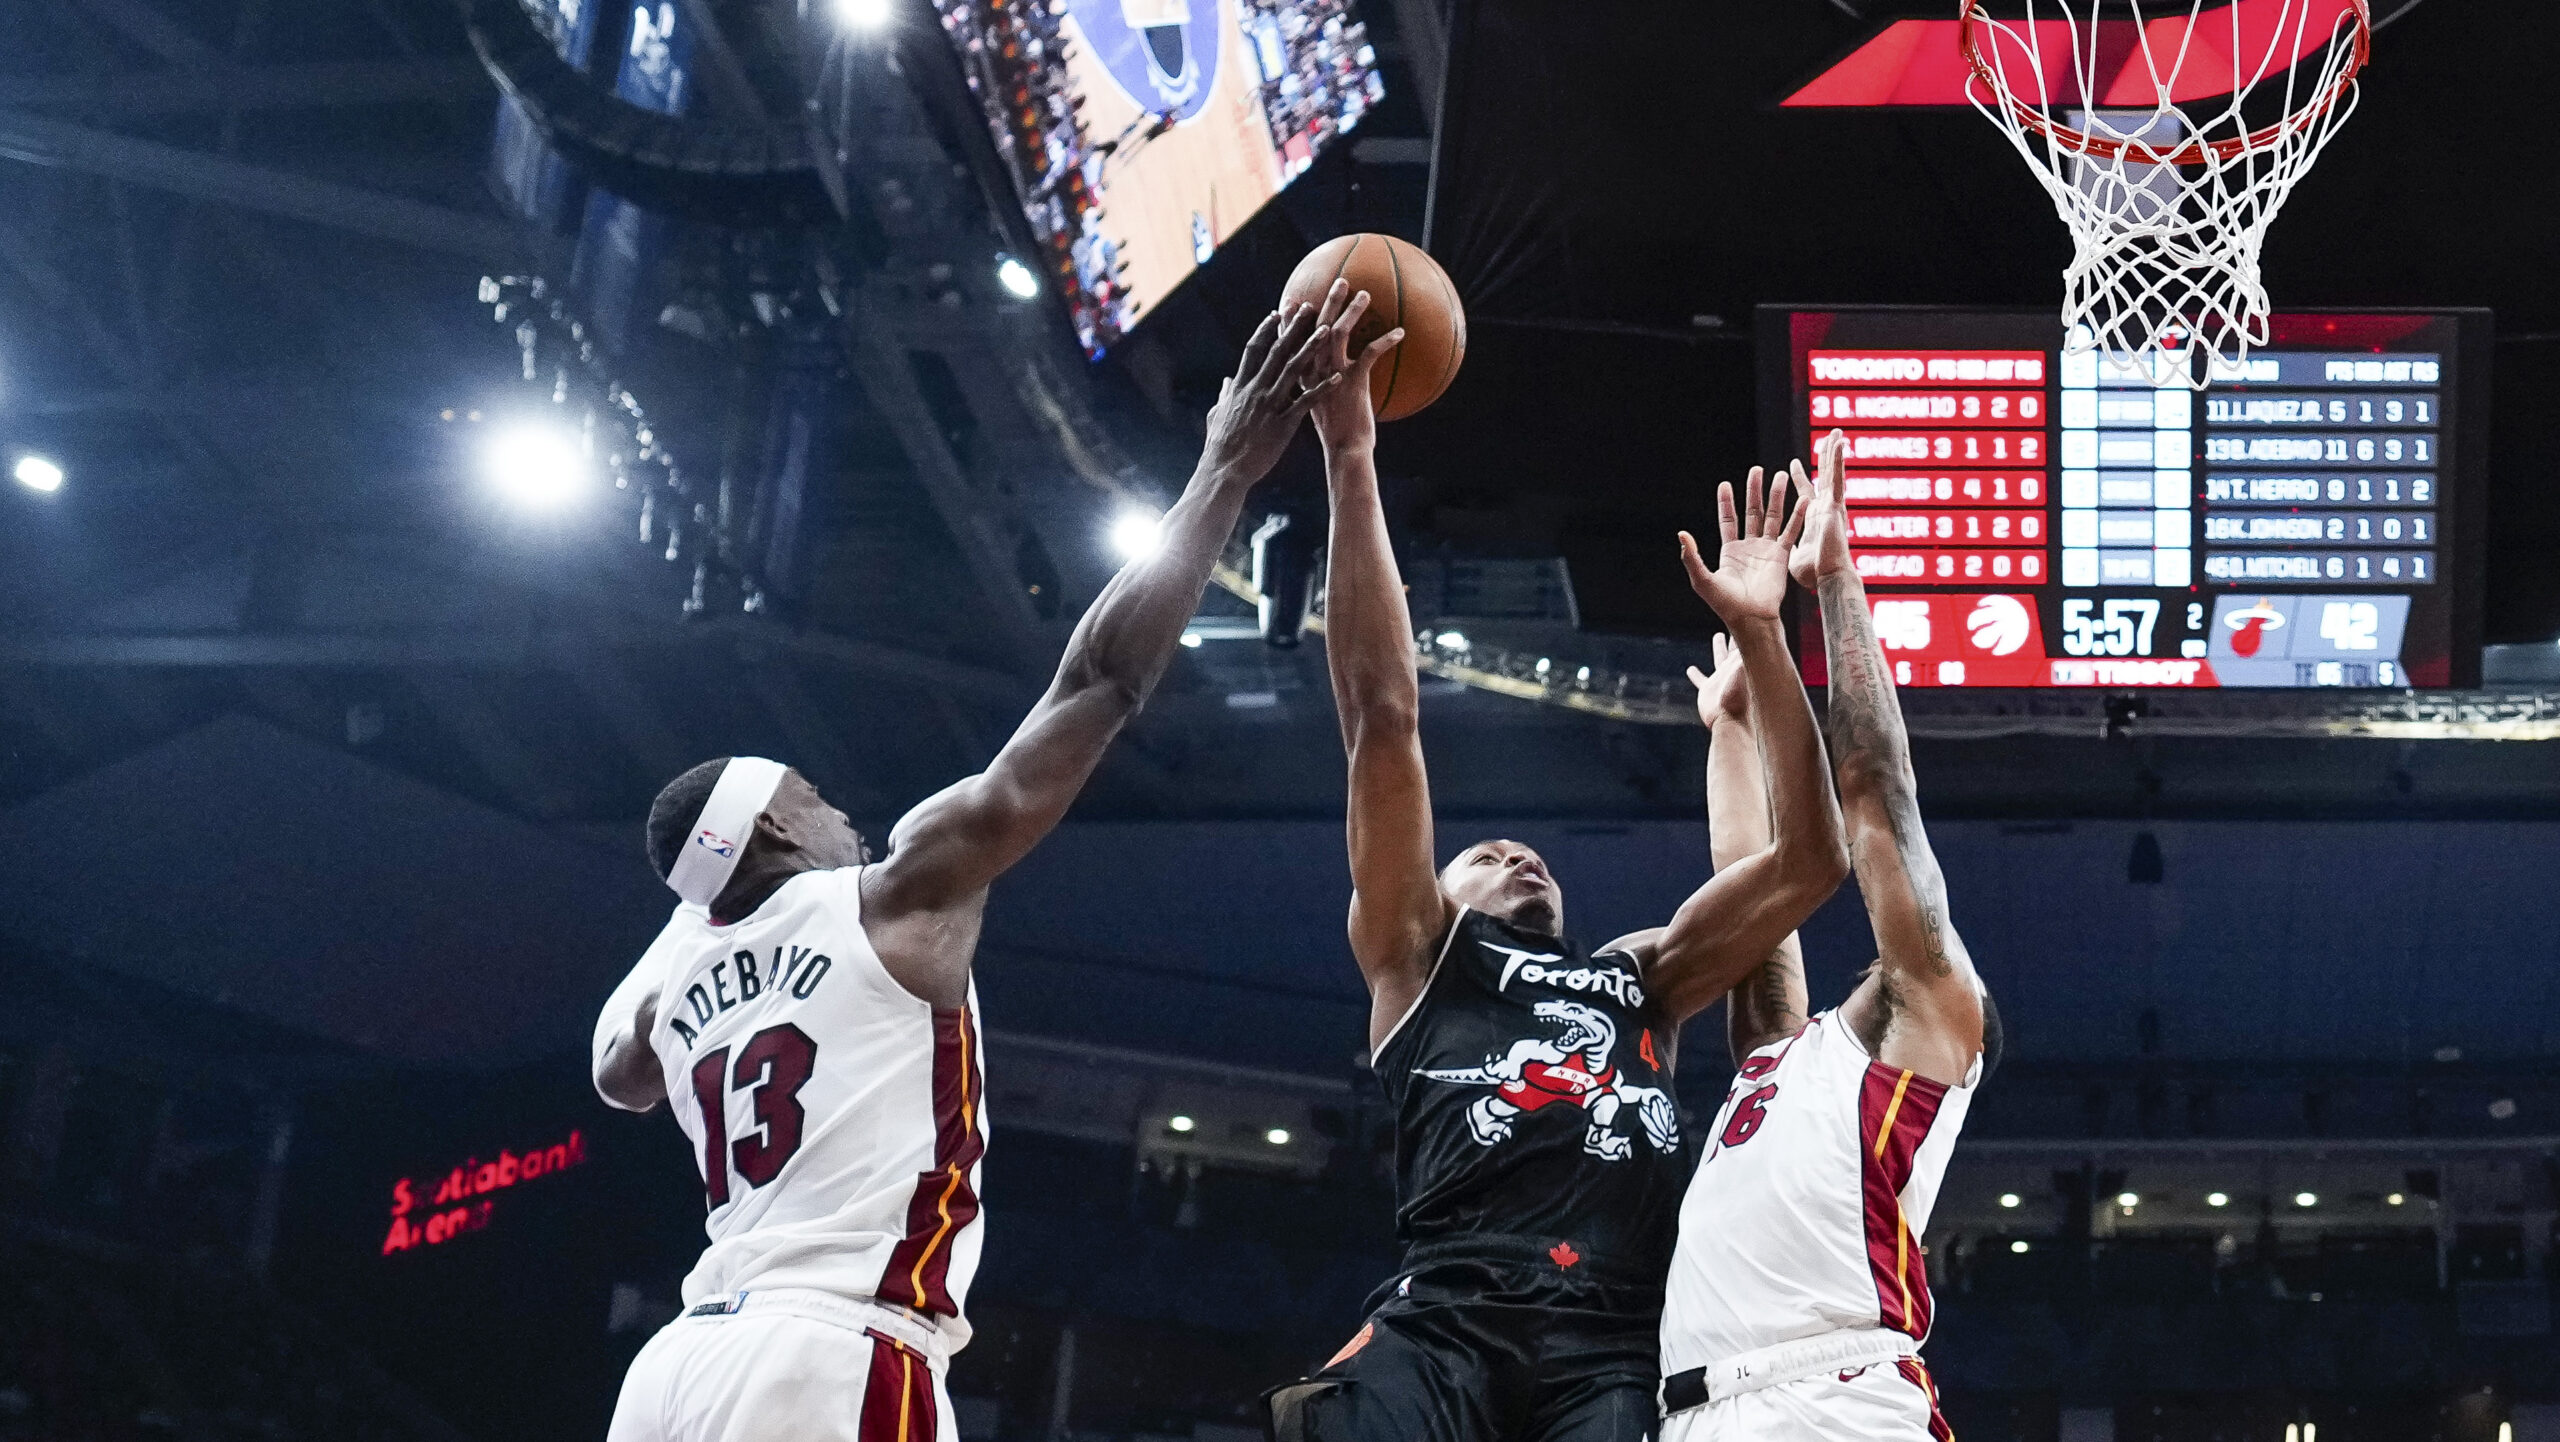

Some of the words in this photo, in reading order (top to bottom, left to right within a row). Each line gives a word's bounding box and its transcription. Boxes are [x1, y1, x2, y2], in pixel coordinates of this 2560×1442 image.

[1811, 358, 1925, 381] TORONTO
[1990, 396, 2009, 419] 2
[2019, 396, 2038, 419] 0
[2329, 400, 2346, 422] 5
[2359, 400, 2373, 422] 1
[2385, 400, 2403, 422] 3
[2415, 400, 2430, 422] 1
[1964, 437, 1980, 460] 1
[1992, 437, 2008, 460] 1
[2020, 437, 2039, 460] 2
[2324, 439, 2349, 461] 11
[2356, 439, 2374, 461] 6
[2385, 439, 2403, 461] 3
[2415, 439, 2428, 461] 1
[1993, 477, 2009, 501] 1
[2020, 477, 2039, 501] 0
[2327, 479, 2345, 501] 9
[2357, 479, 2372, 501] 1
[2385, 479, 2400, 501] 1
[2412, 479, 2430, 501] 2
[1846, 516, 1930, 539] .WALTER
[1965, 516, 1981, 539] 1
[1992, 516, 2011, 539] 2
[2020, 516, 2040, 539] 0
[2327, 518, 2344, 540] 2
[2357, 518, 2371, 540] 1
[2383, 518, 2401, 540] 0
[2413, 518, 2427, 540] 1
[1964, 555, 1983, 578] 2
[1992, 555, 2012, 578] 0
[2021, 555, 2040, 578] 0
[2326, 557, 2344, 579] 6
[2357, 557, 2370, 579] 1
[2382, 557, 2400, 579] 4
[2413, 557, 2425, 579] 1
[2063, 599, 2161, 656] 5:57
[2187, 603, 2203, 630] 2
[2319, 602, 2379, 651] 42
[1478, 940, 1645, 1009] Toronto
[670, 946, 832, 1051] ADEBAYO
[691, 1021, 818, 1214] 13
[391, 1129, 587, 1217] Sotiabank
[382, 1200, 494, 1257] Aren
